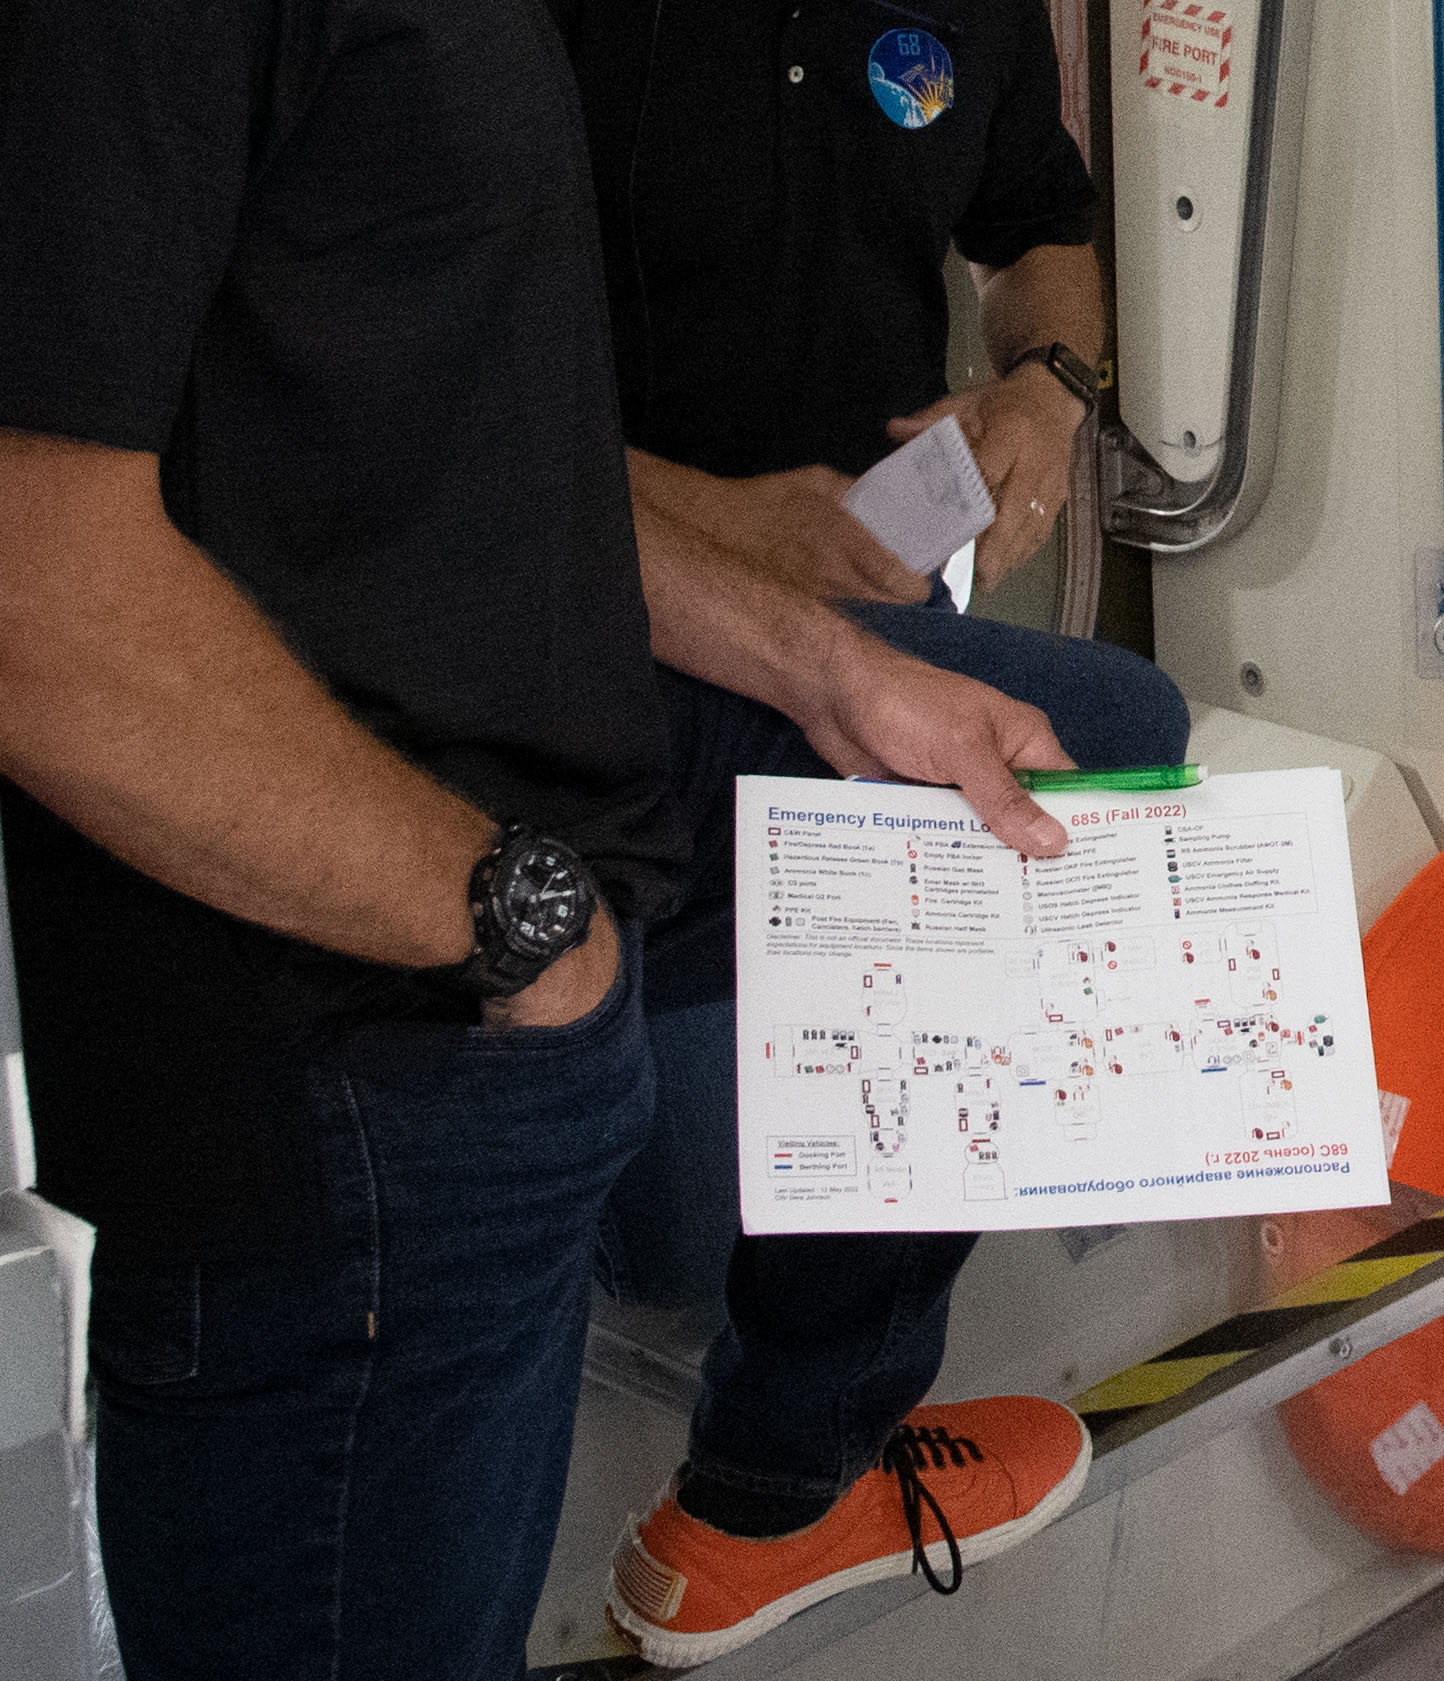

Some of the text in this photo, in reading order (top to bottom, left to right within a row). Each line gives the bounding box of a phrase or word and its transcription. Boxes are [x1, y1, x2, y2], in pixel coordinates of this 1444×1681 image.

[898, 33, 921, 55] 68
[1152, 35, 1218, 65] FIRE PORT
[768, 807, 866, 828] Emergency
[873, 812, 965, 831] Equipment
[1071, 805, 1187, 826] 68S (Fall 2022)
[1225, 1150, 1259, 1165] 2022
[1264, 1143, 1315, 1161] (осень
[1014, 1161, 1350, 1197] Расположение аварийного оборудования:
